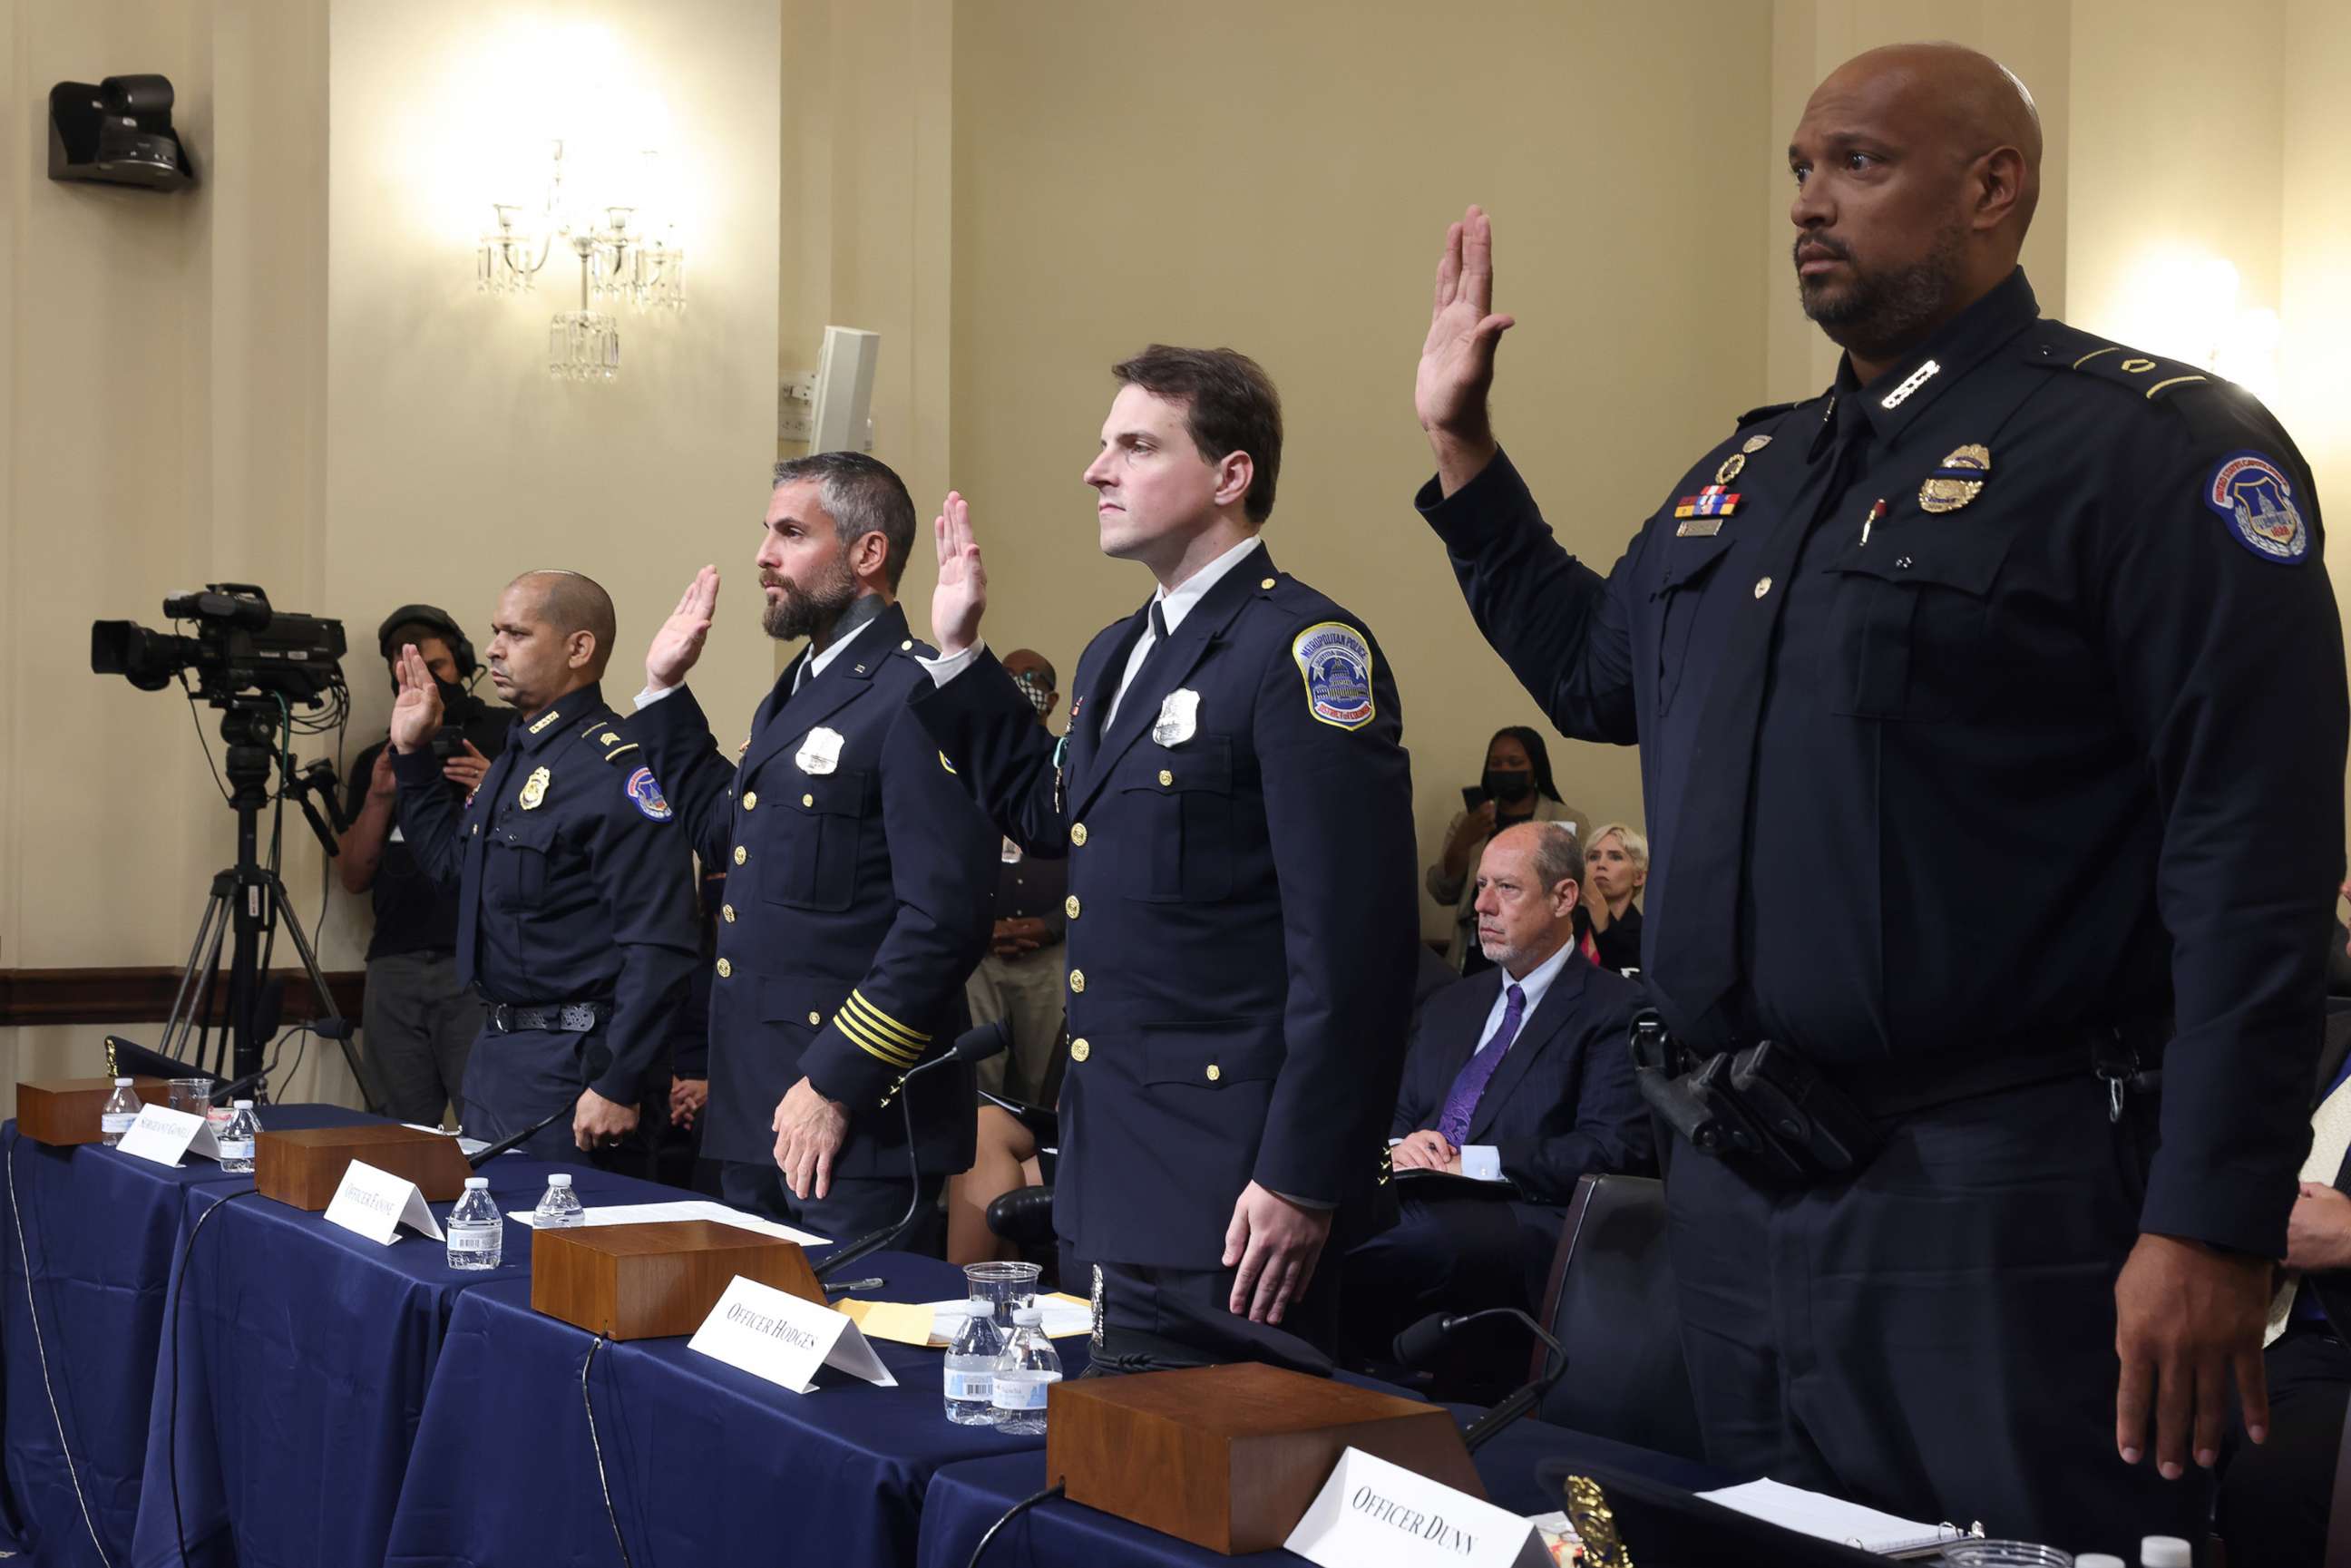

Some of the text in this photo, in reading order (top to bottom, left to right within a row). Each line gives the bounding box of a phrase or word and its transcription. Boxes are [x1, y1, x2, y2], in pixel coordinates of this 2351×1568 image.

[1301, 632, 1346, 658] METROPOLITAN
[1346, 638, 1369, 659] POLICE
[345, 1183, 371, 1207] OFFICER
[727, 1302, 819, 1350] OFFICER HODGES
[1352, 1485, 1479, 1556] OFFICER DUNN
